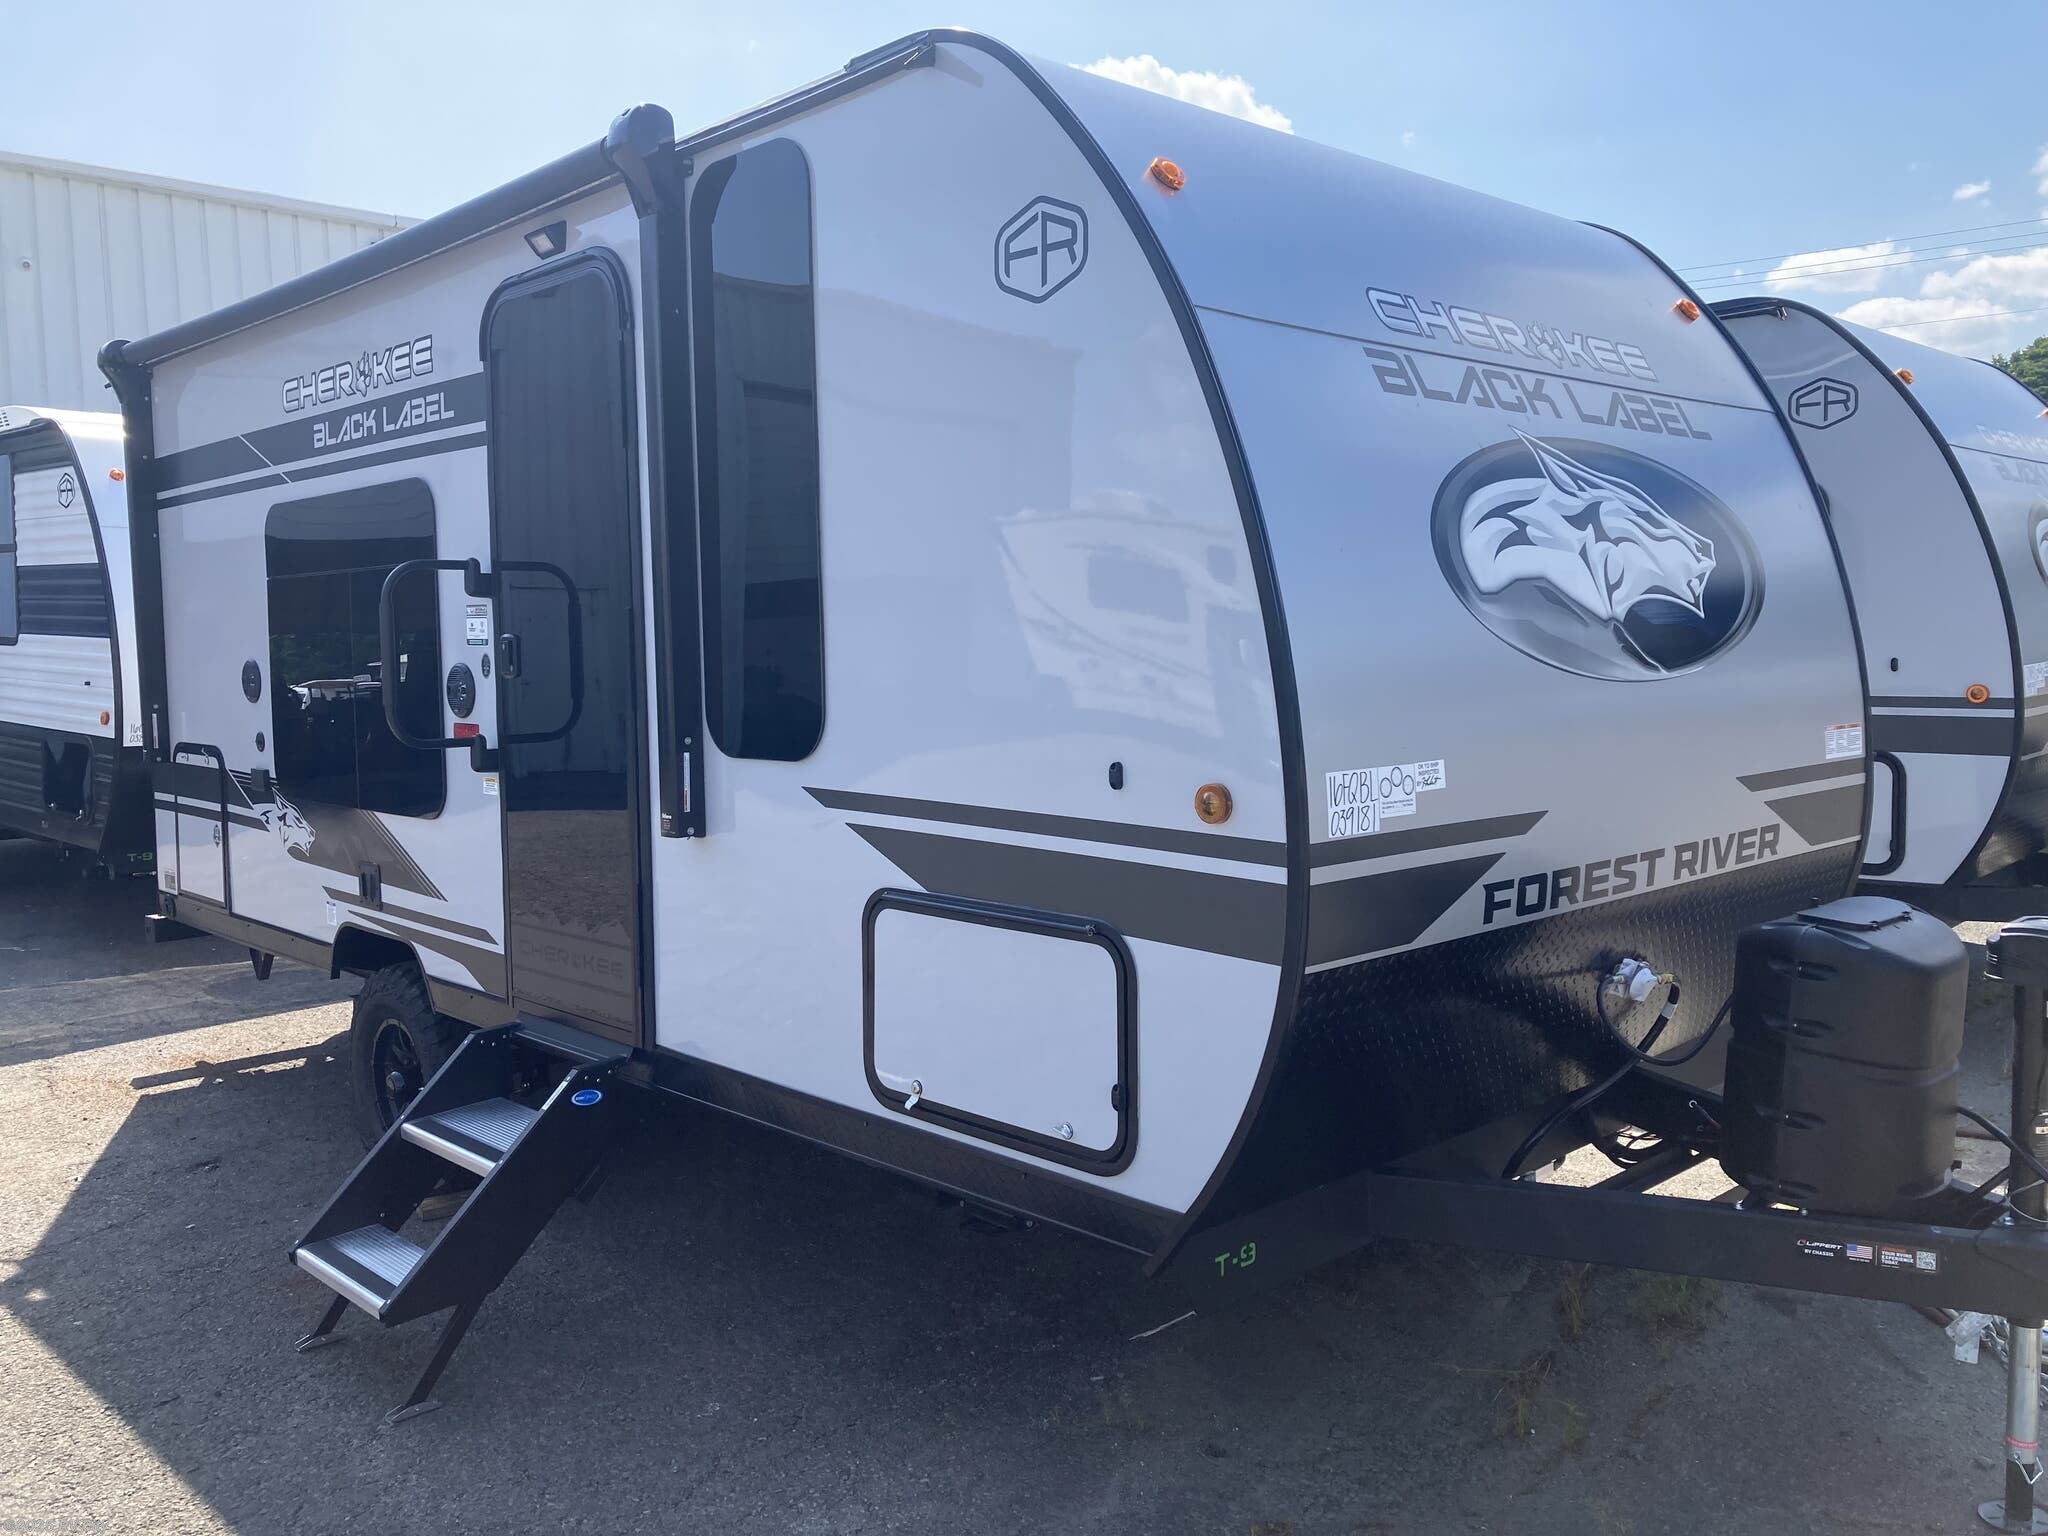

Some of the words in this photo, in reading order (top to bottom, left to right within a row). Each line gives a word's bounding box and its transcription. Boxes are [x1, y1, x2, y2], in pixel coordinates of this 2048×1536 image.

[312, 408, 377, 449] BLACK
[382, 391, 455, 433] LABEL
[1362, 346, 1563, 420] BLACK
[1562, 382, 1713, 441] LABEL
[1330, 802, 1377, 837] 039181
[1482, 847, 1666, 925] FOREST
[1673, 822, 1781, 881] RIVER
